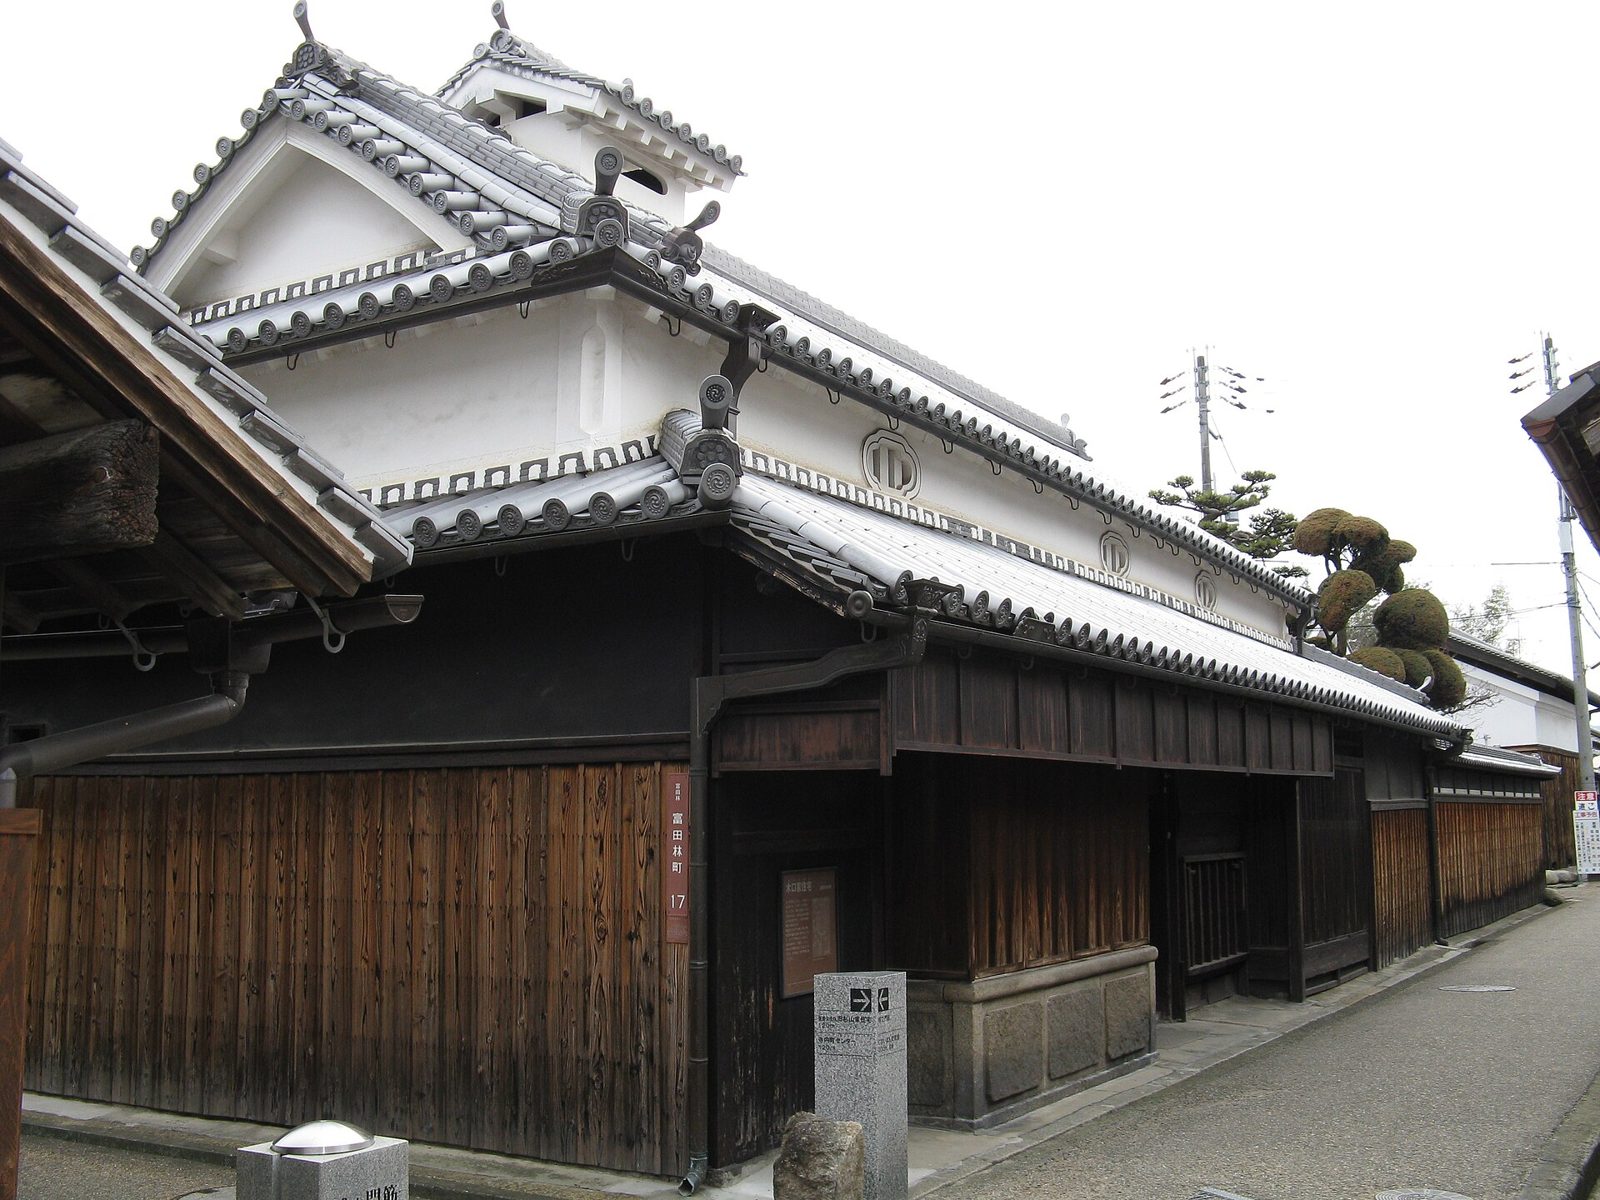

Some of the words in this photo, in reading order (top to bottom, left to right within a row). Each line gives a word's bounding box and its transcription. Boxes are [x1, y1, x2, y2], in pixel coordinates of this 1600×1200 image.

[1577, 791, 1594, 801] 注意
[672, 812, 683, 873] 富田林町
[671, 894, 686, 909] 17
